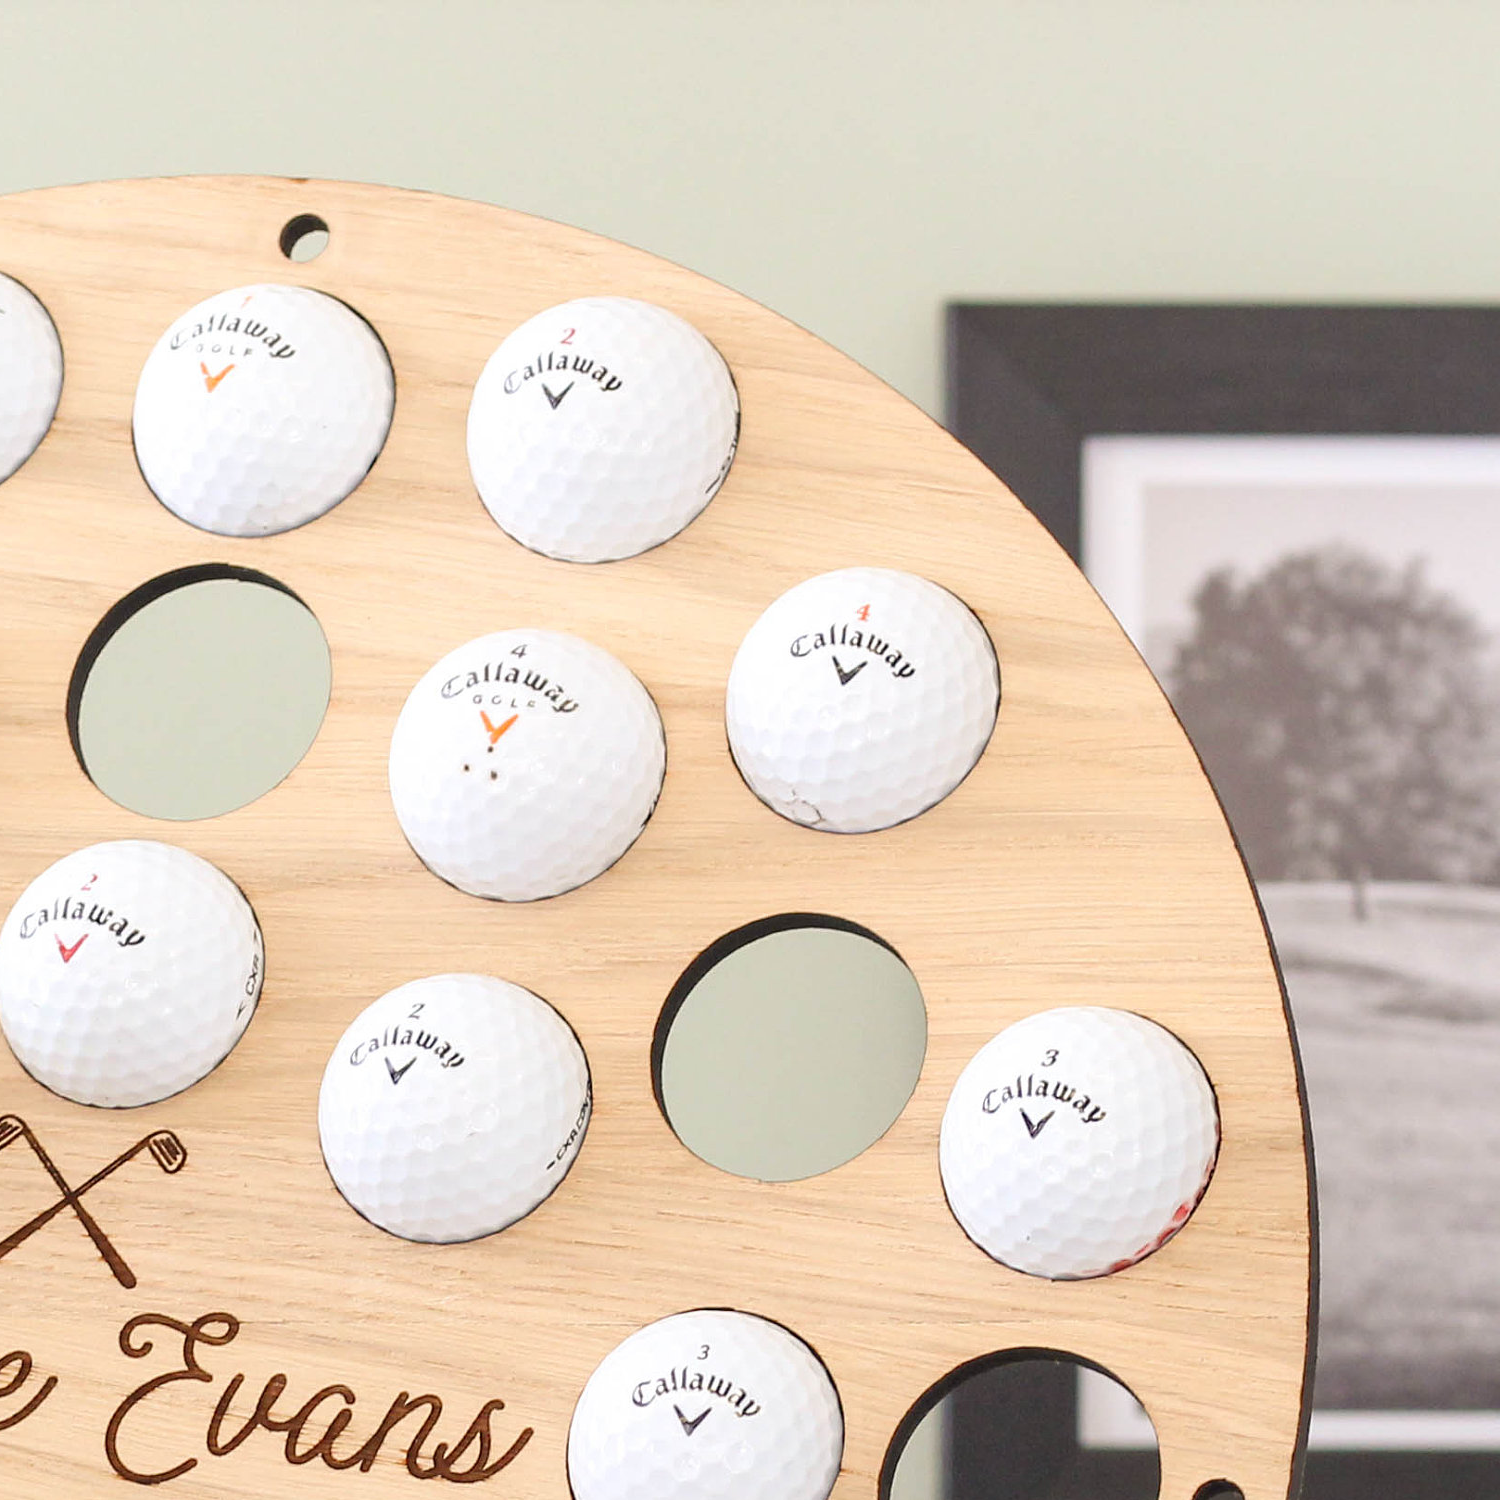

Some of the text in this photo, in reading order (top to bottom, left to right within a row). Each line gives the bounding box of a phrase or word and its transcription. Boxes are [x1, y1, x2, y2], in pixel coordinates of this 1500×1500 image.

[169, 311, 297, 360] Callaway
[559, 327, 576, 346] 2
[503, 351, 624, 397] Callaway
[856, 603, 871, 623] 4
[510, 644, 528, 660] 4
[789, 623, 917, 684] Callaway
[440, 661, 580, 714] Callaway
[472, 694, 537, 709] GOLF
[80, 873, 99, 892] 2
[19, 897, 147, 948] Callaway
[407, 1003, 426, 1020] 2
[349, 1024, 465, 1073] Callaway
[1040, 1048, 1060, 1068] 3
[981, 1073, 1107, 1128] Callaway
[696, 1343, 711, 1361] 3
[104, 1311, 535, 1485] Evans
[631, 1365, 762, 1422] Callaway
